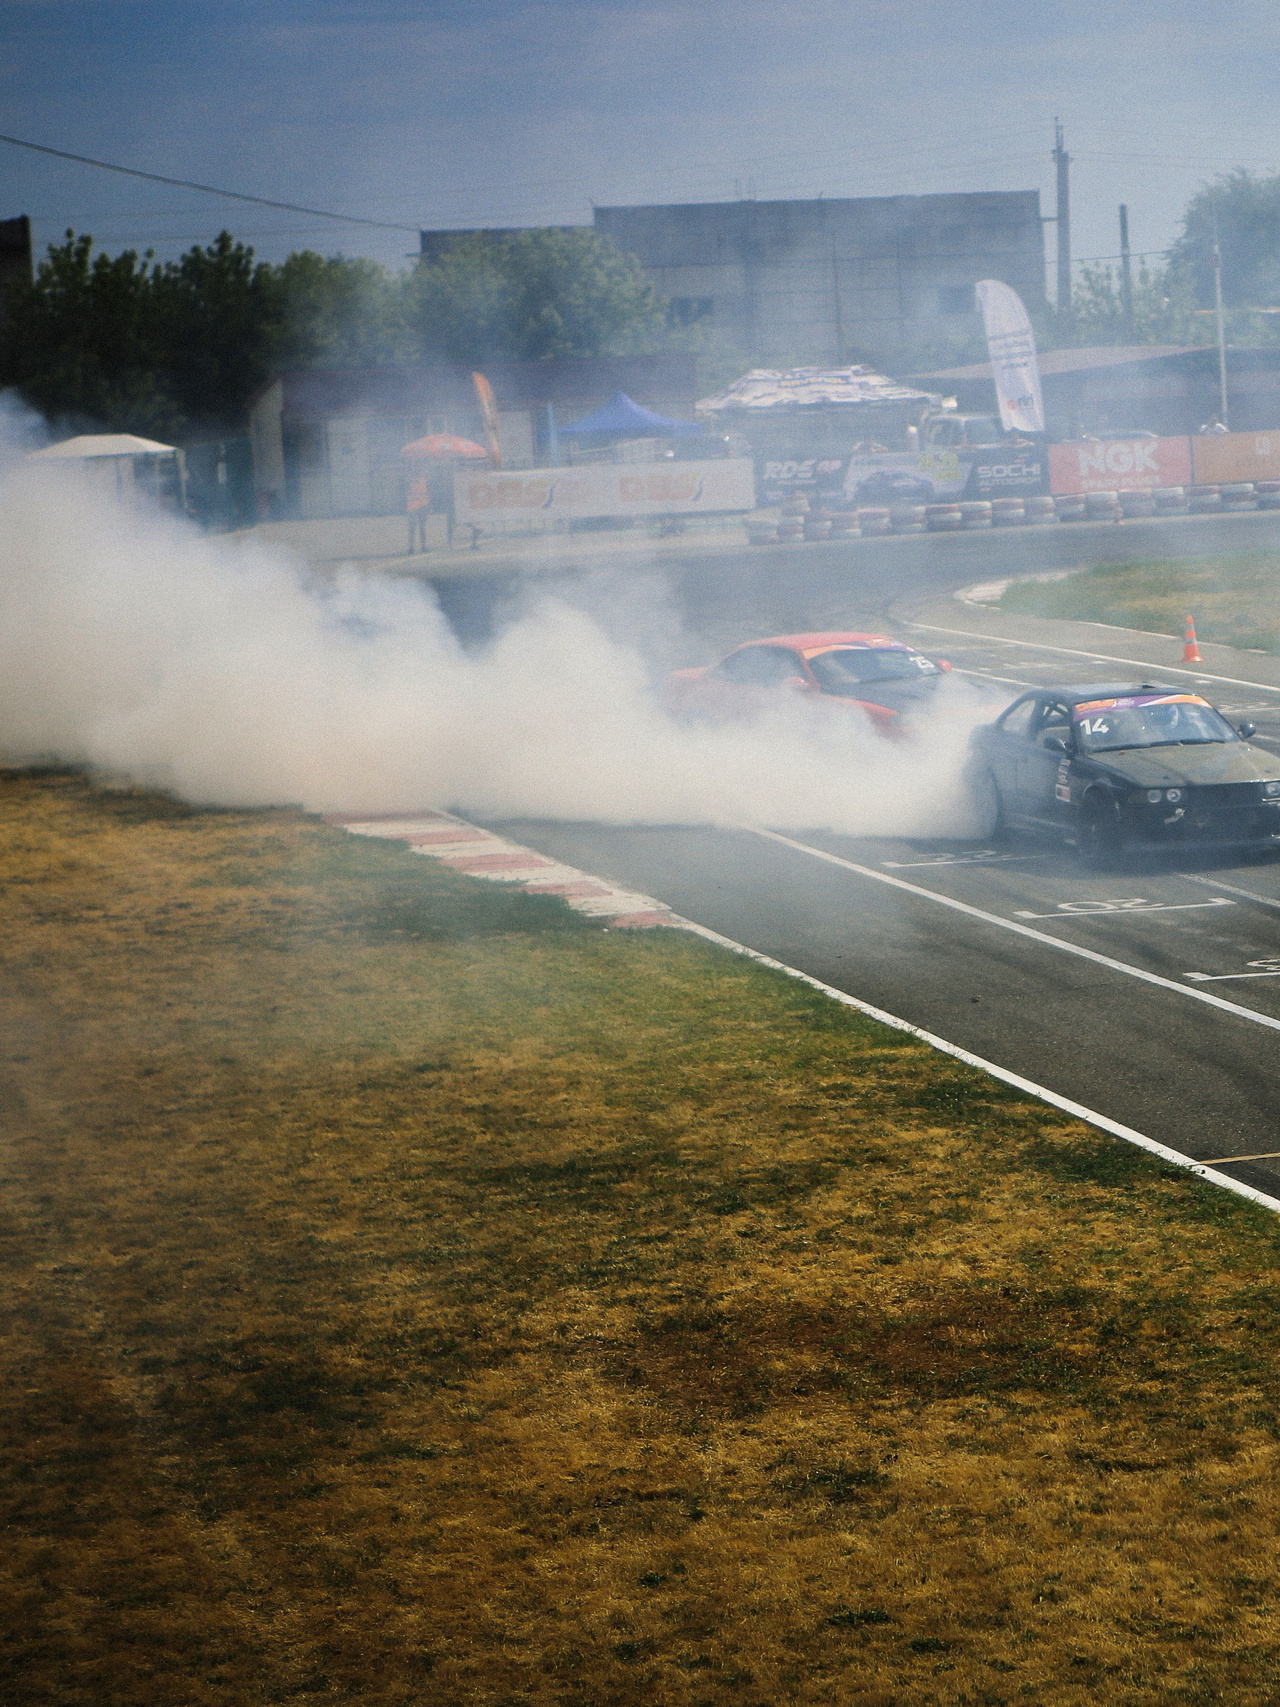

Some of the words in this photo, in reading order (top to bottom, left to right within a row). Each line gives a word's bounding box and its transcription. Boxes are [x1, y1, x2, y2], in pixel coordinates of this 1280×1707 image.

[1077, 441, 1160, 477] NGK
[977, 462, 1041, 478] SOCHI
[1079, 718, 1110, 736] 14
[1056, 897, 1164, 912] 20
